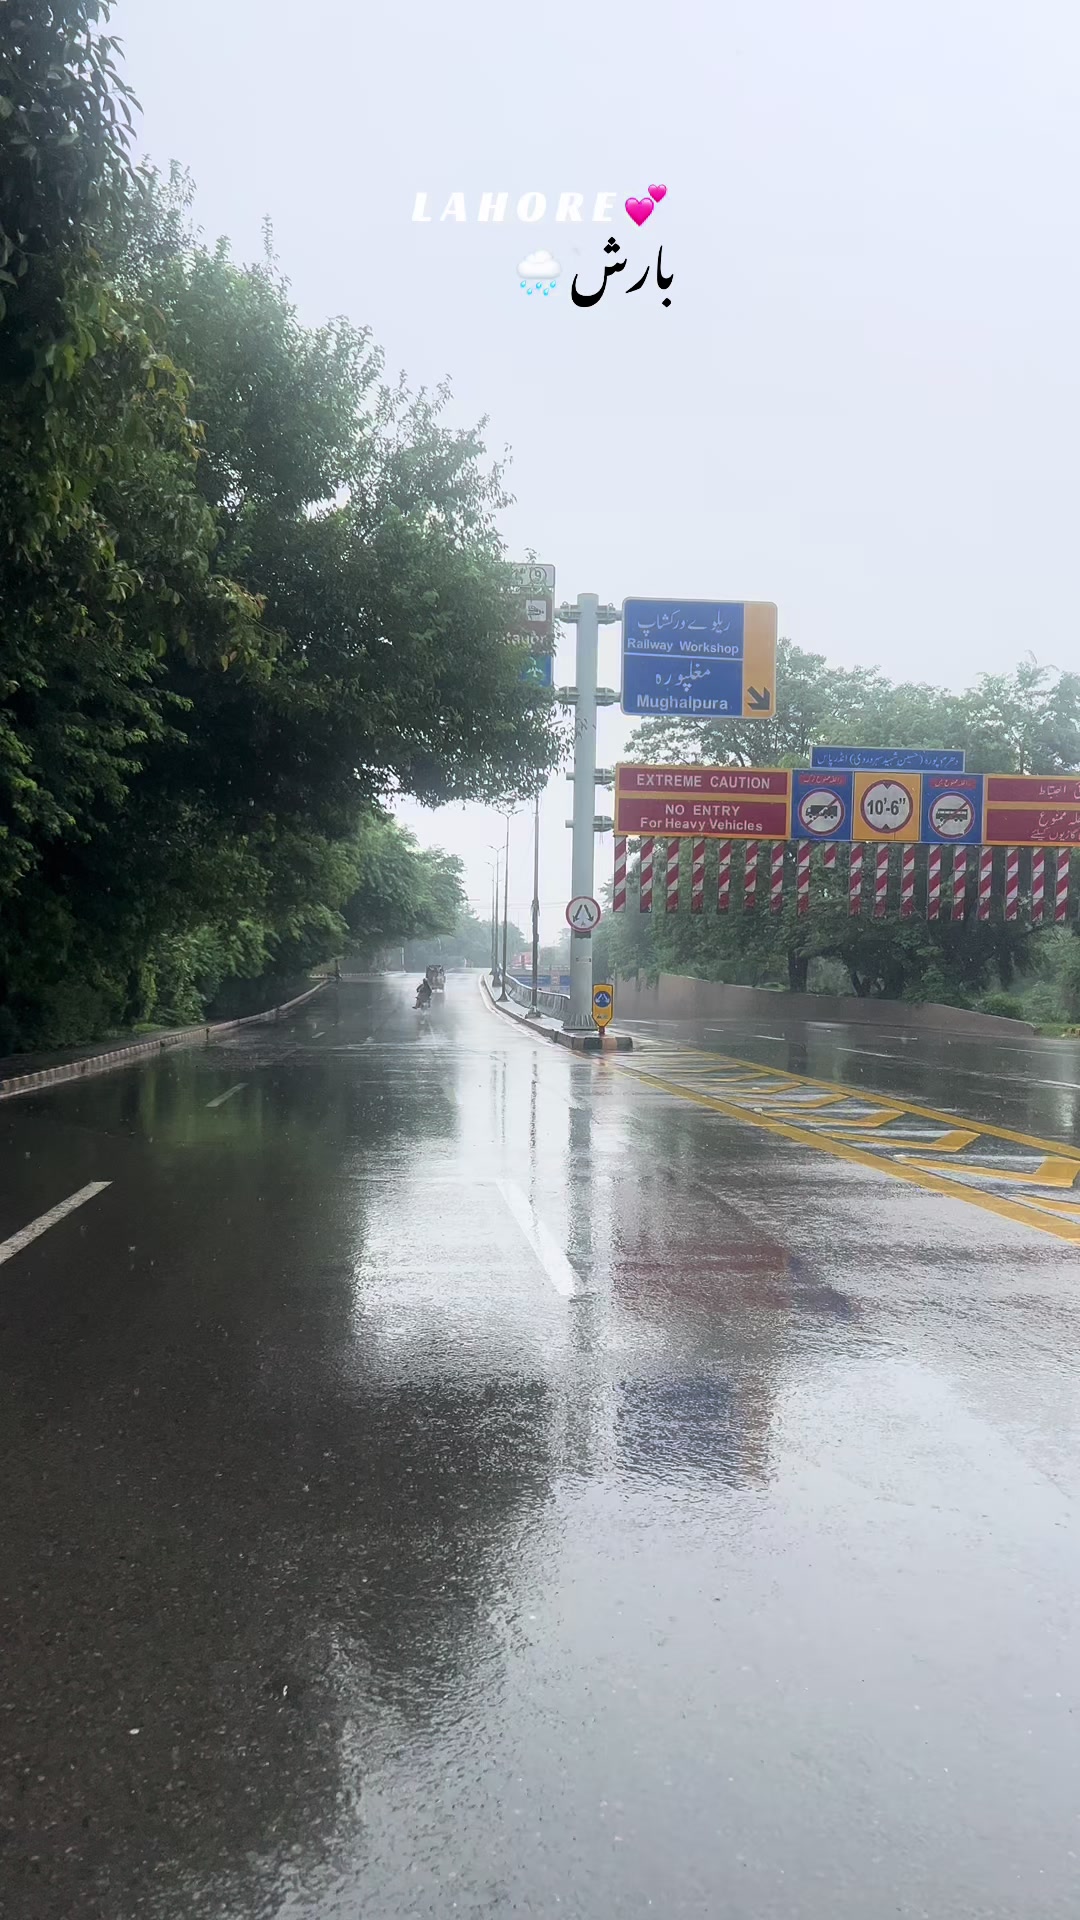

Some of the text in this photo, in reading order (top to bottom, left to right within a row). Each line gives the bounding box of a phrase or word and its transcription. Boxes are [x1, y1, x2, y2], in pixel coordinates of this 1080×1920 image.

[637, 609, 686, 636] ورکشاپ
[627, 637, 739, 656] Railway Workshop
[636, 694, 728, 711] Mughalpura
[636, 773, 770, 789] EXTREME CAUTION
[665, 804, 741, 817] NO ENTRY
[640, 817, 763, 832] For Heavy Vehicles
